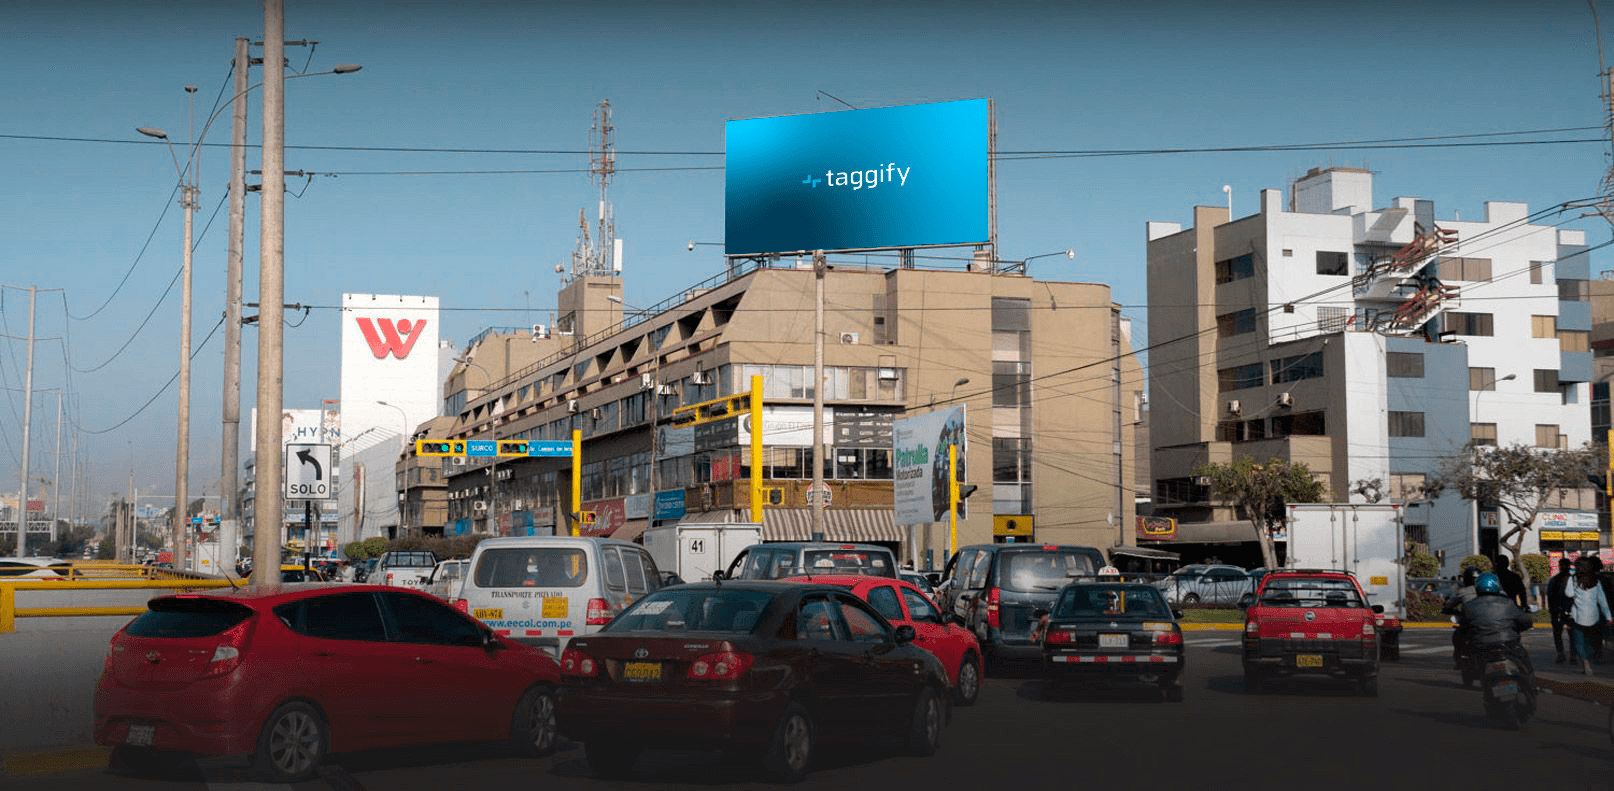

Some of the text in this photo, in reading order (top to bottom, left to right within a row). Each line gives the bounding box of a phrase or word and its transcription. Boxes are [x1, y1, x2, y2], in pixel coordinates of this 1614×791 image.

[825, 162, 911, 190] taggify
[895, 443, 929, 468] Patrulla
[290, 483, 326, 495] SOLO
[691, 539, 703, 553] 41
[491, 591, 533, 599] TRANSPORTE
